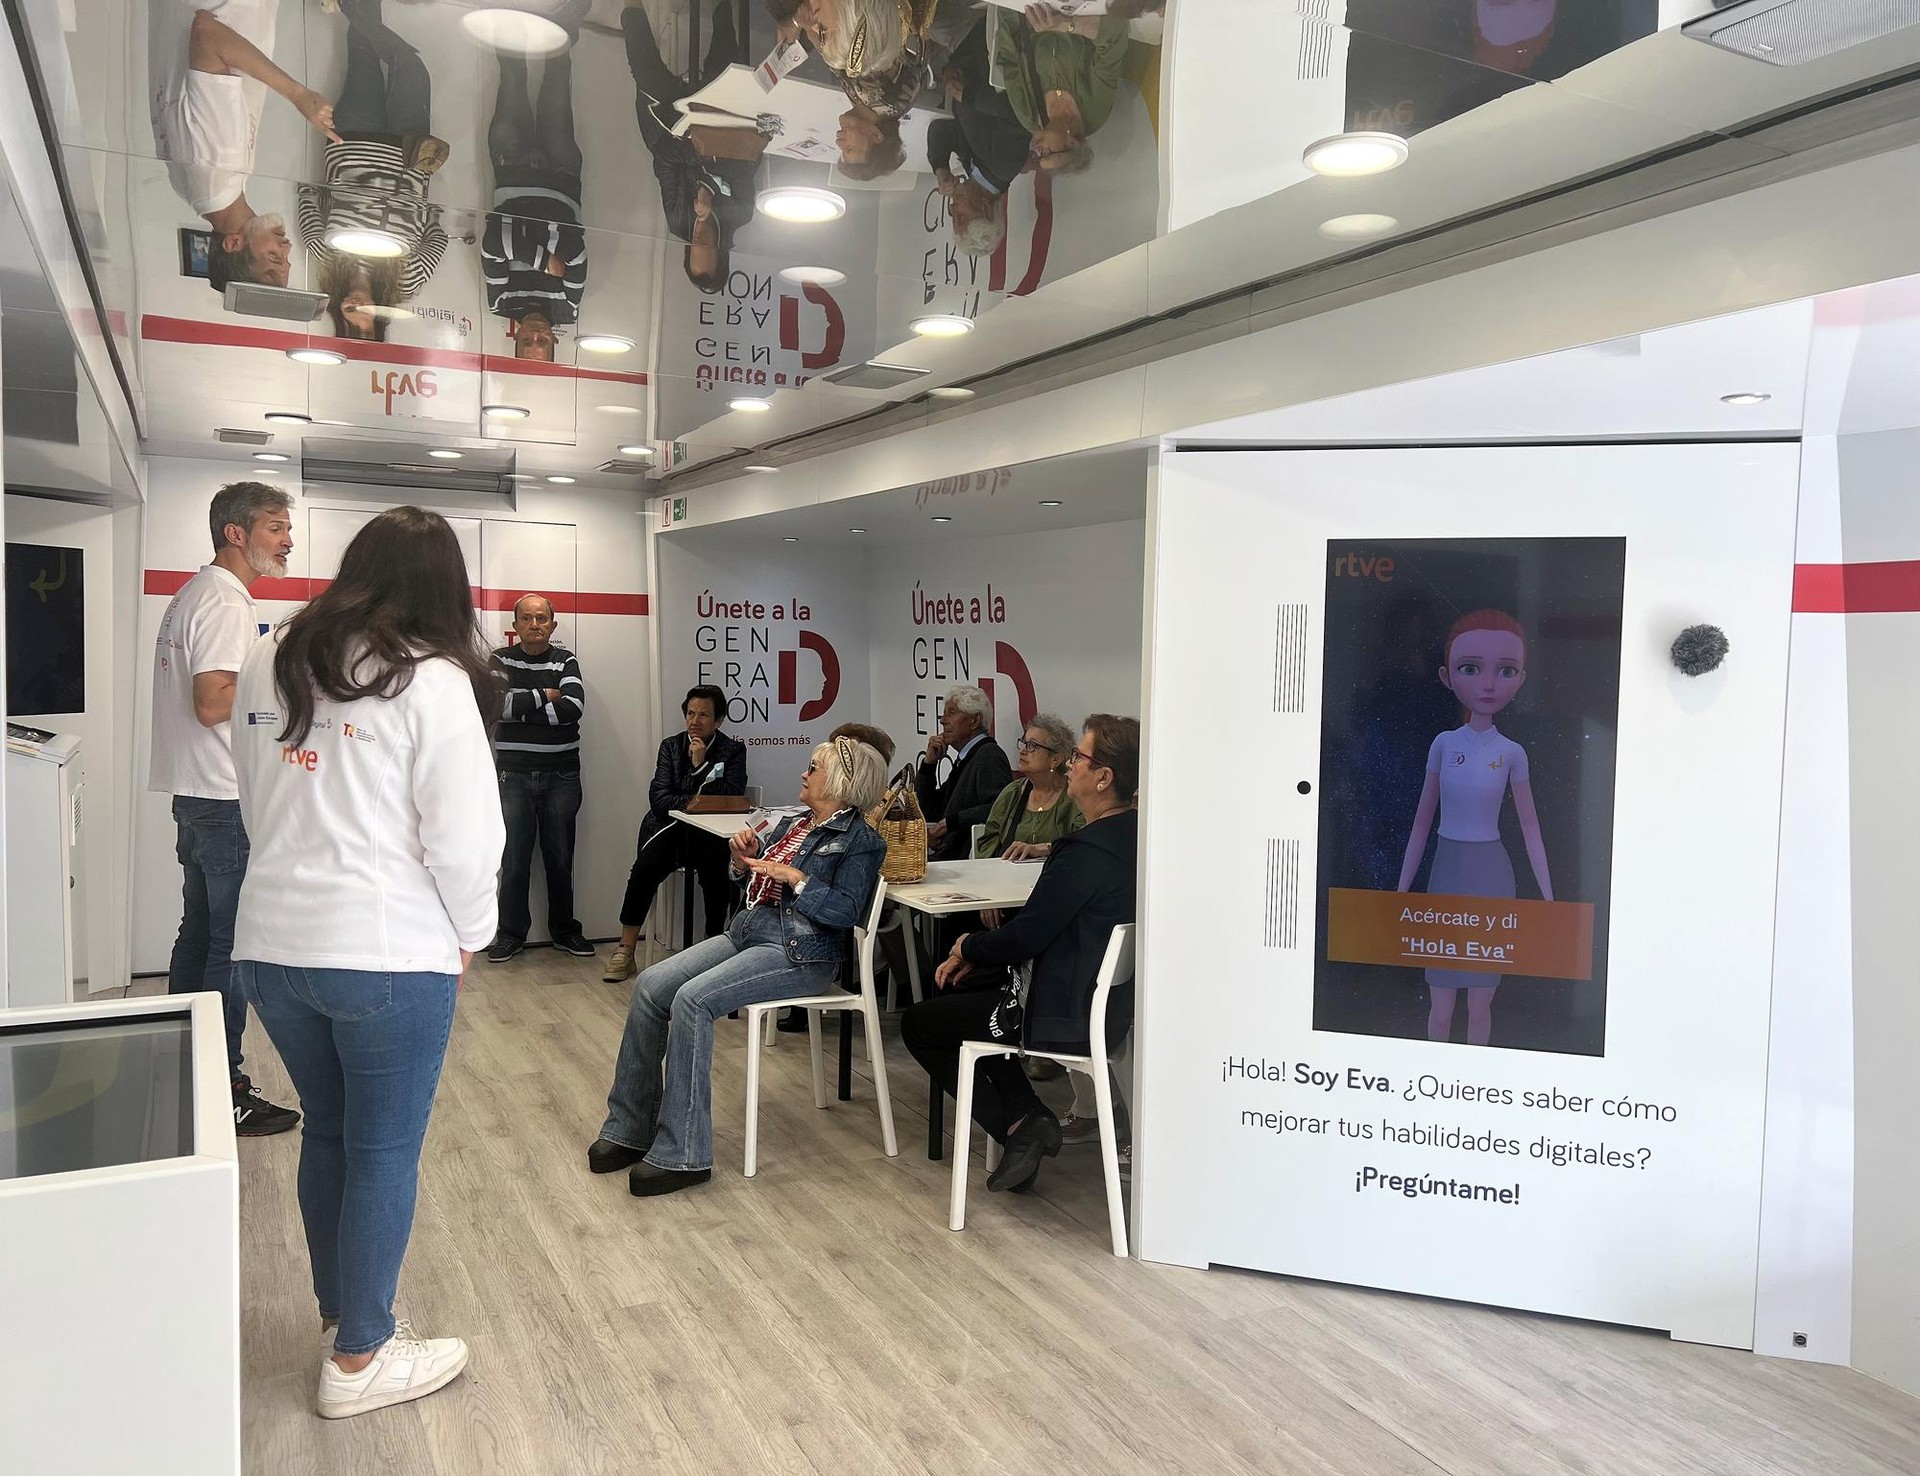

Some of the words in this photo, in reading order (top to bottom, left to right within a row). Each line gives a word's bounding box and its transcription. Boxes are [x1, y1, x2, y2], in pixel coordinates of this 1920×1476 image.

[1335, 552, 1395, 582] rtve
[697, 589, 765, 619] Únete
[772, 604, 784, 620] a
[793, 598, 811, 620] la
[912, 580, 965, 625] Únete
[970, 597, 981, 623] a
[987, 583, 1005, 623] la
[696, 625, 769, 653] GEN
[913, 637, 970, 681] GEN
[726, 691, 769, 723] ÓN
[748, 736, 785, 746] somos
[788, 734, 811, 746] más
[282, 744, 318, 772] rtve
[1400, 907, 1480, 927] Acércate
[1485, 915, 1496, 931] y
[1502, 913, 1518, 929] di
[1401, 937, 1457, 956] "Hola
[1466, 941, 1514, 959] Eva"
[1222, 1056, 1286, 1082] ¡Hola!
[1294, 1063, 1339, 1092] Soy
[1347, 1067, 1395, 1093] Eva.
[1403, 1074, 1513, 1106] ¿Quieres
[1522, 1087, 1594, 1113] saber
[1602, 1095, 1677, 1122] cómo
[1241, 1110, 1330, 1135] mejorar
[1338, 1117, 1373, 1139] tus
[1382, 1118, 1520, 1156] habilidades
[1529, 1136, 1651, 1170] digitales?
[1356, 1166, 1520, 1205] ¡Pregúntame!
